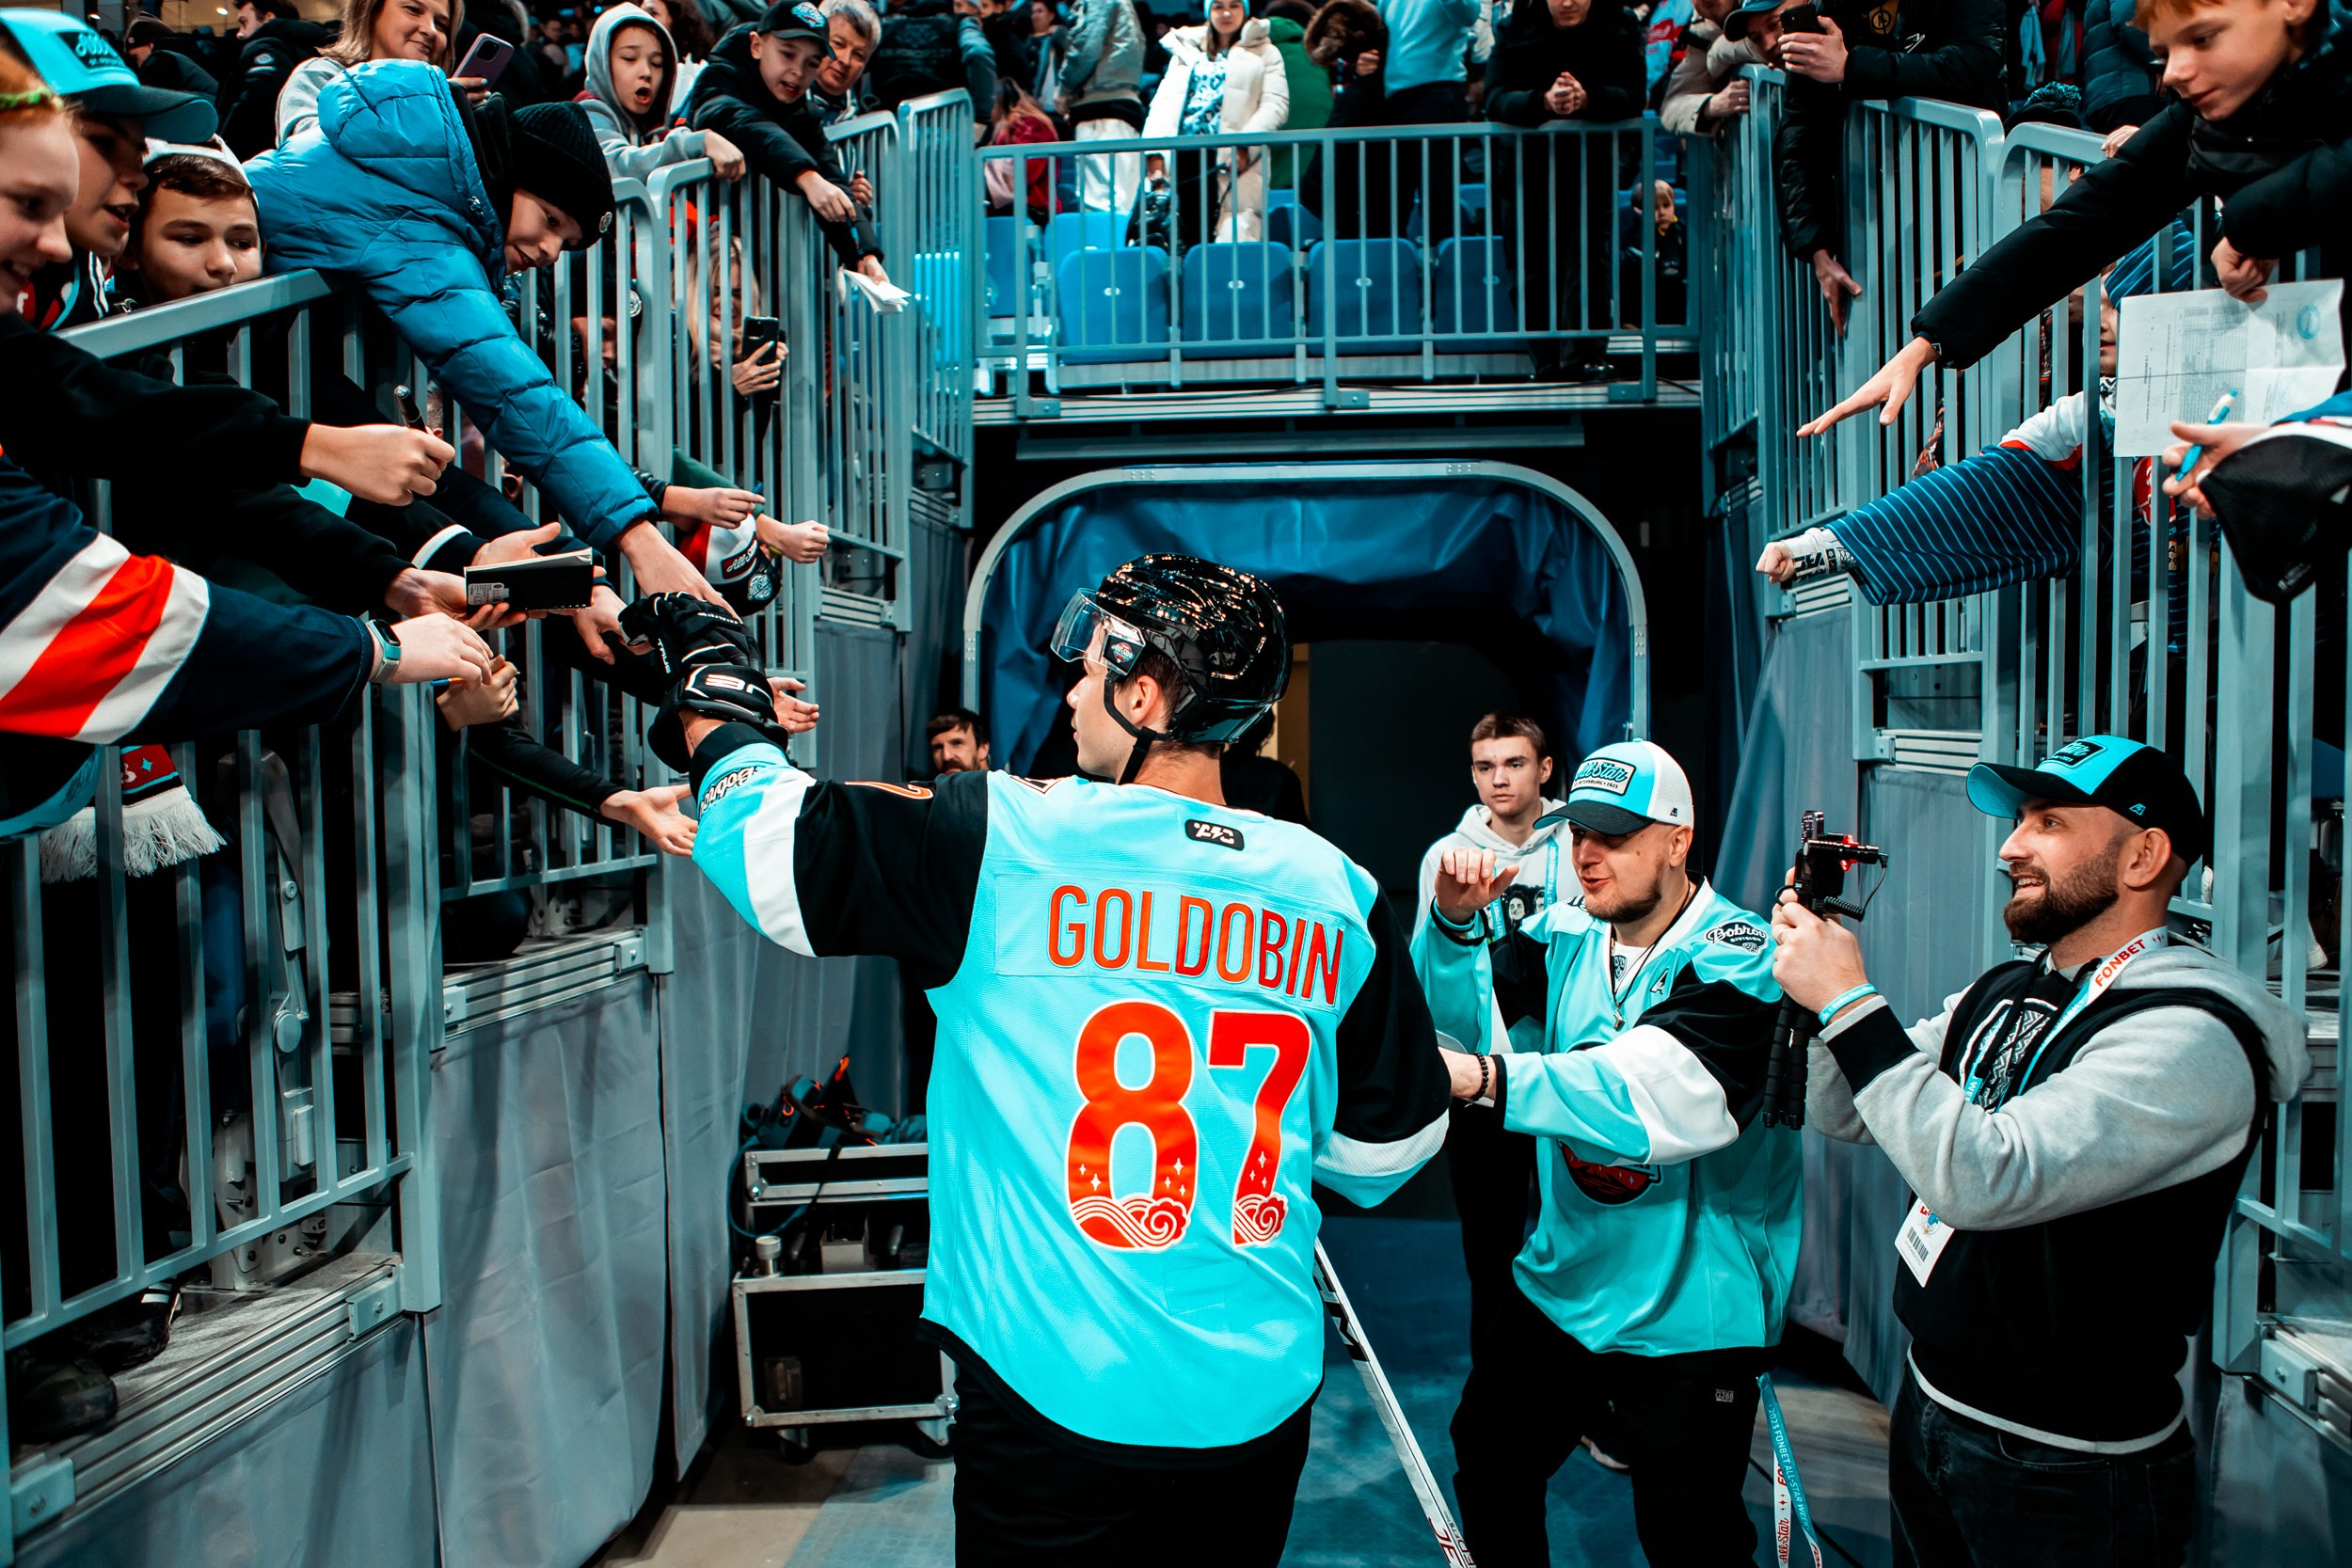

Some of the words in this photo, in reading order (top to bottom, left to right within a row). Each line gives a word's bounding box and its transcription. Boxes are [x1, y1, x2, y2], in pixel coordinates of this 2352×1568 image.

[1048, 885, 1343, 1006] GOLDOBIN
[1707, 924, 1767, 943] Bobrov
[2095, 939, 2146, 988] FONBET
[1067, 999, 1312, 1252] 87
[1768, 1408, 1780, 1429] 2023
[1773, 1429, 1791, 1464] FONBET
[1785, 1464, 1804, 1505] ALL-STAR
[1796, 1504, 1809, 1528] WEEK
[1777, 1517, 1790, 1564] All-Star
